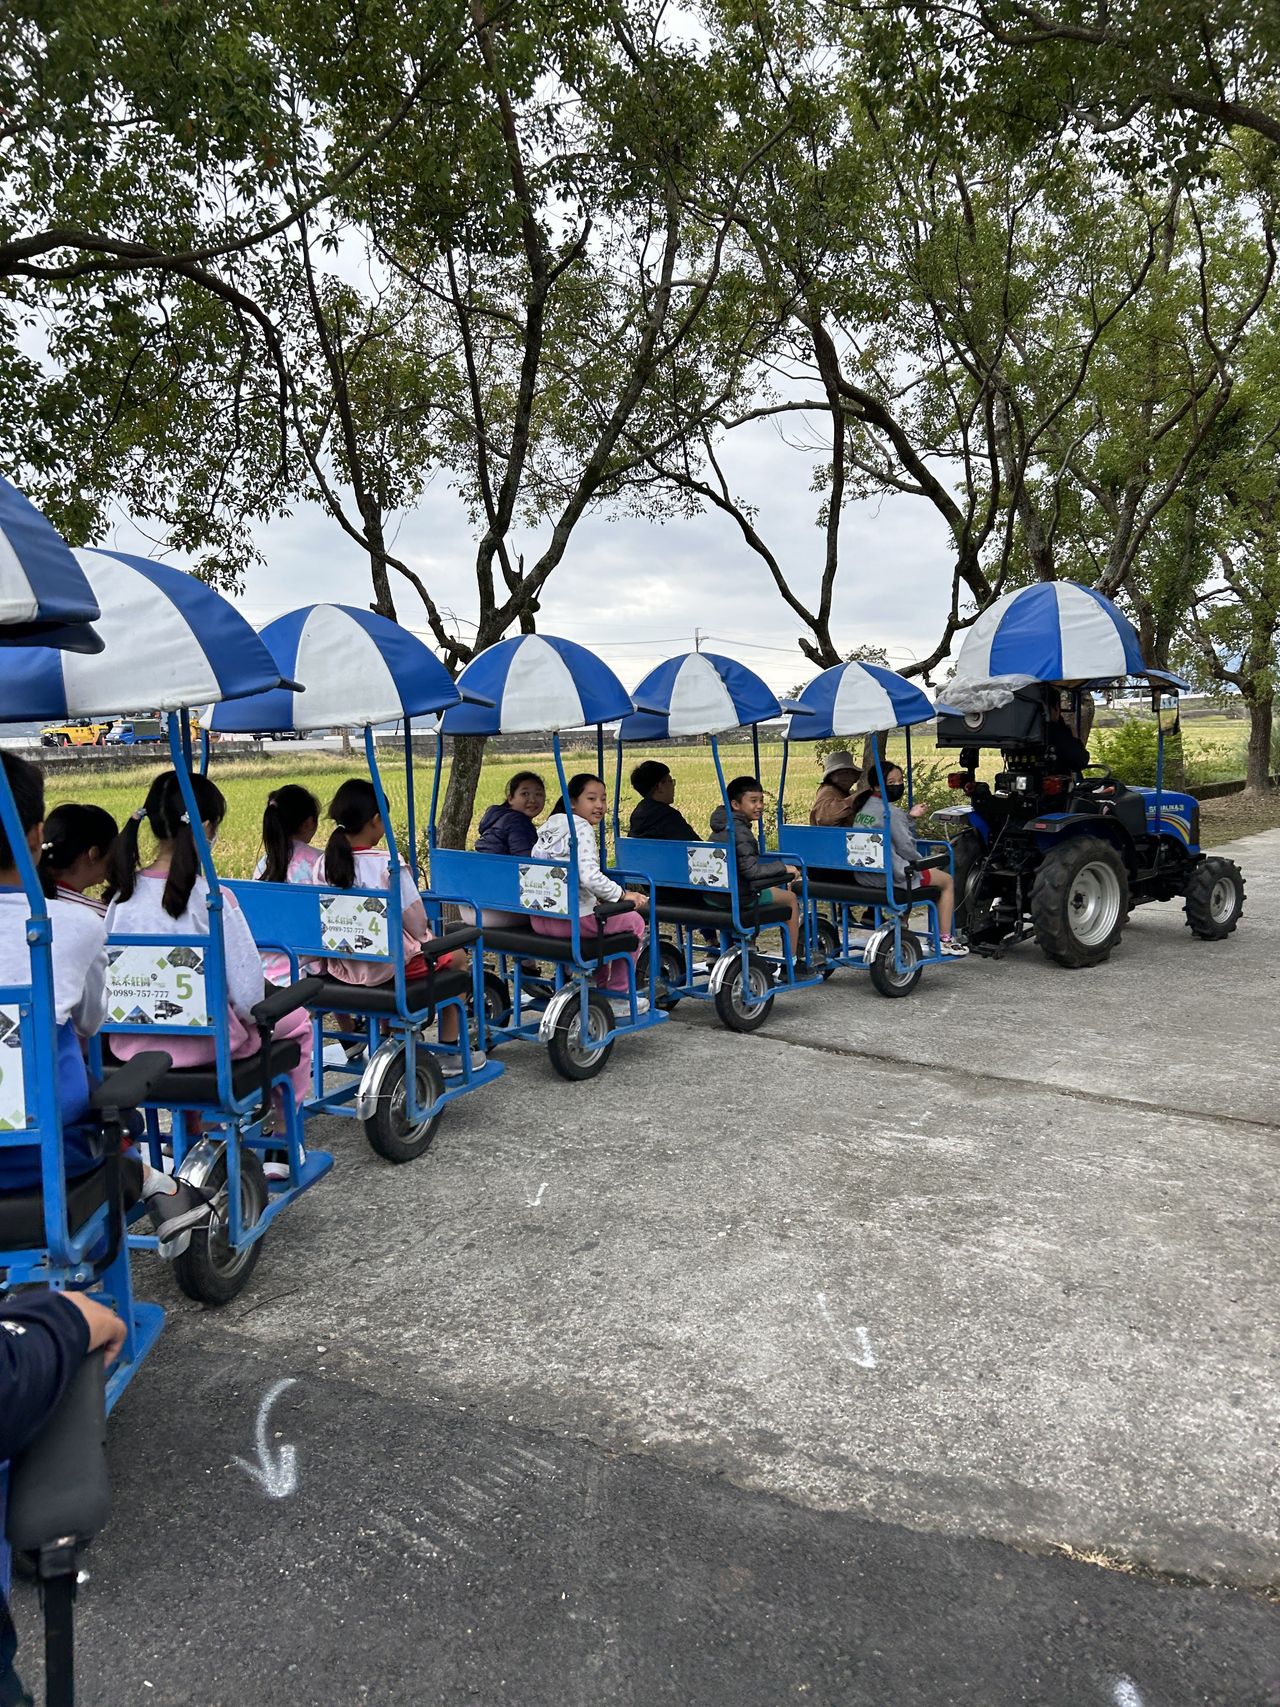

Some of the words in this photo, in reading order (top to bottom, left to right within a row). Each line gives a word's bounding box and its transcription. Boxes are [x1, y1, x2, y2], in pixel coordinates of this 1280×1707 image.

[873, 845, 878, 857] 1
[715, 861, 723, 875] 2
[553, 882, 562, 898] 3
[368, 916, 381, 936] 4
[113, 989, 169, 999] 0989-757-777
[176, 973, 193, 1000] 5
